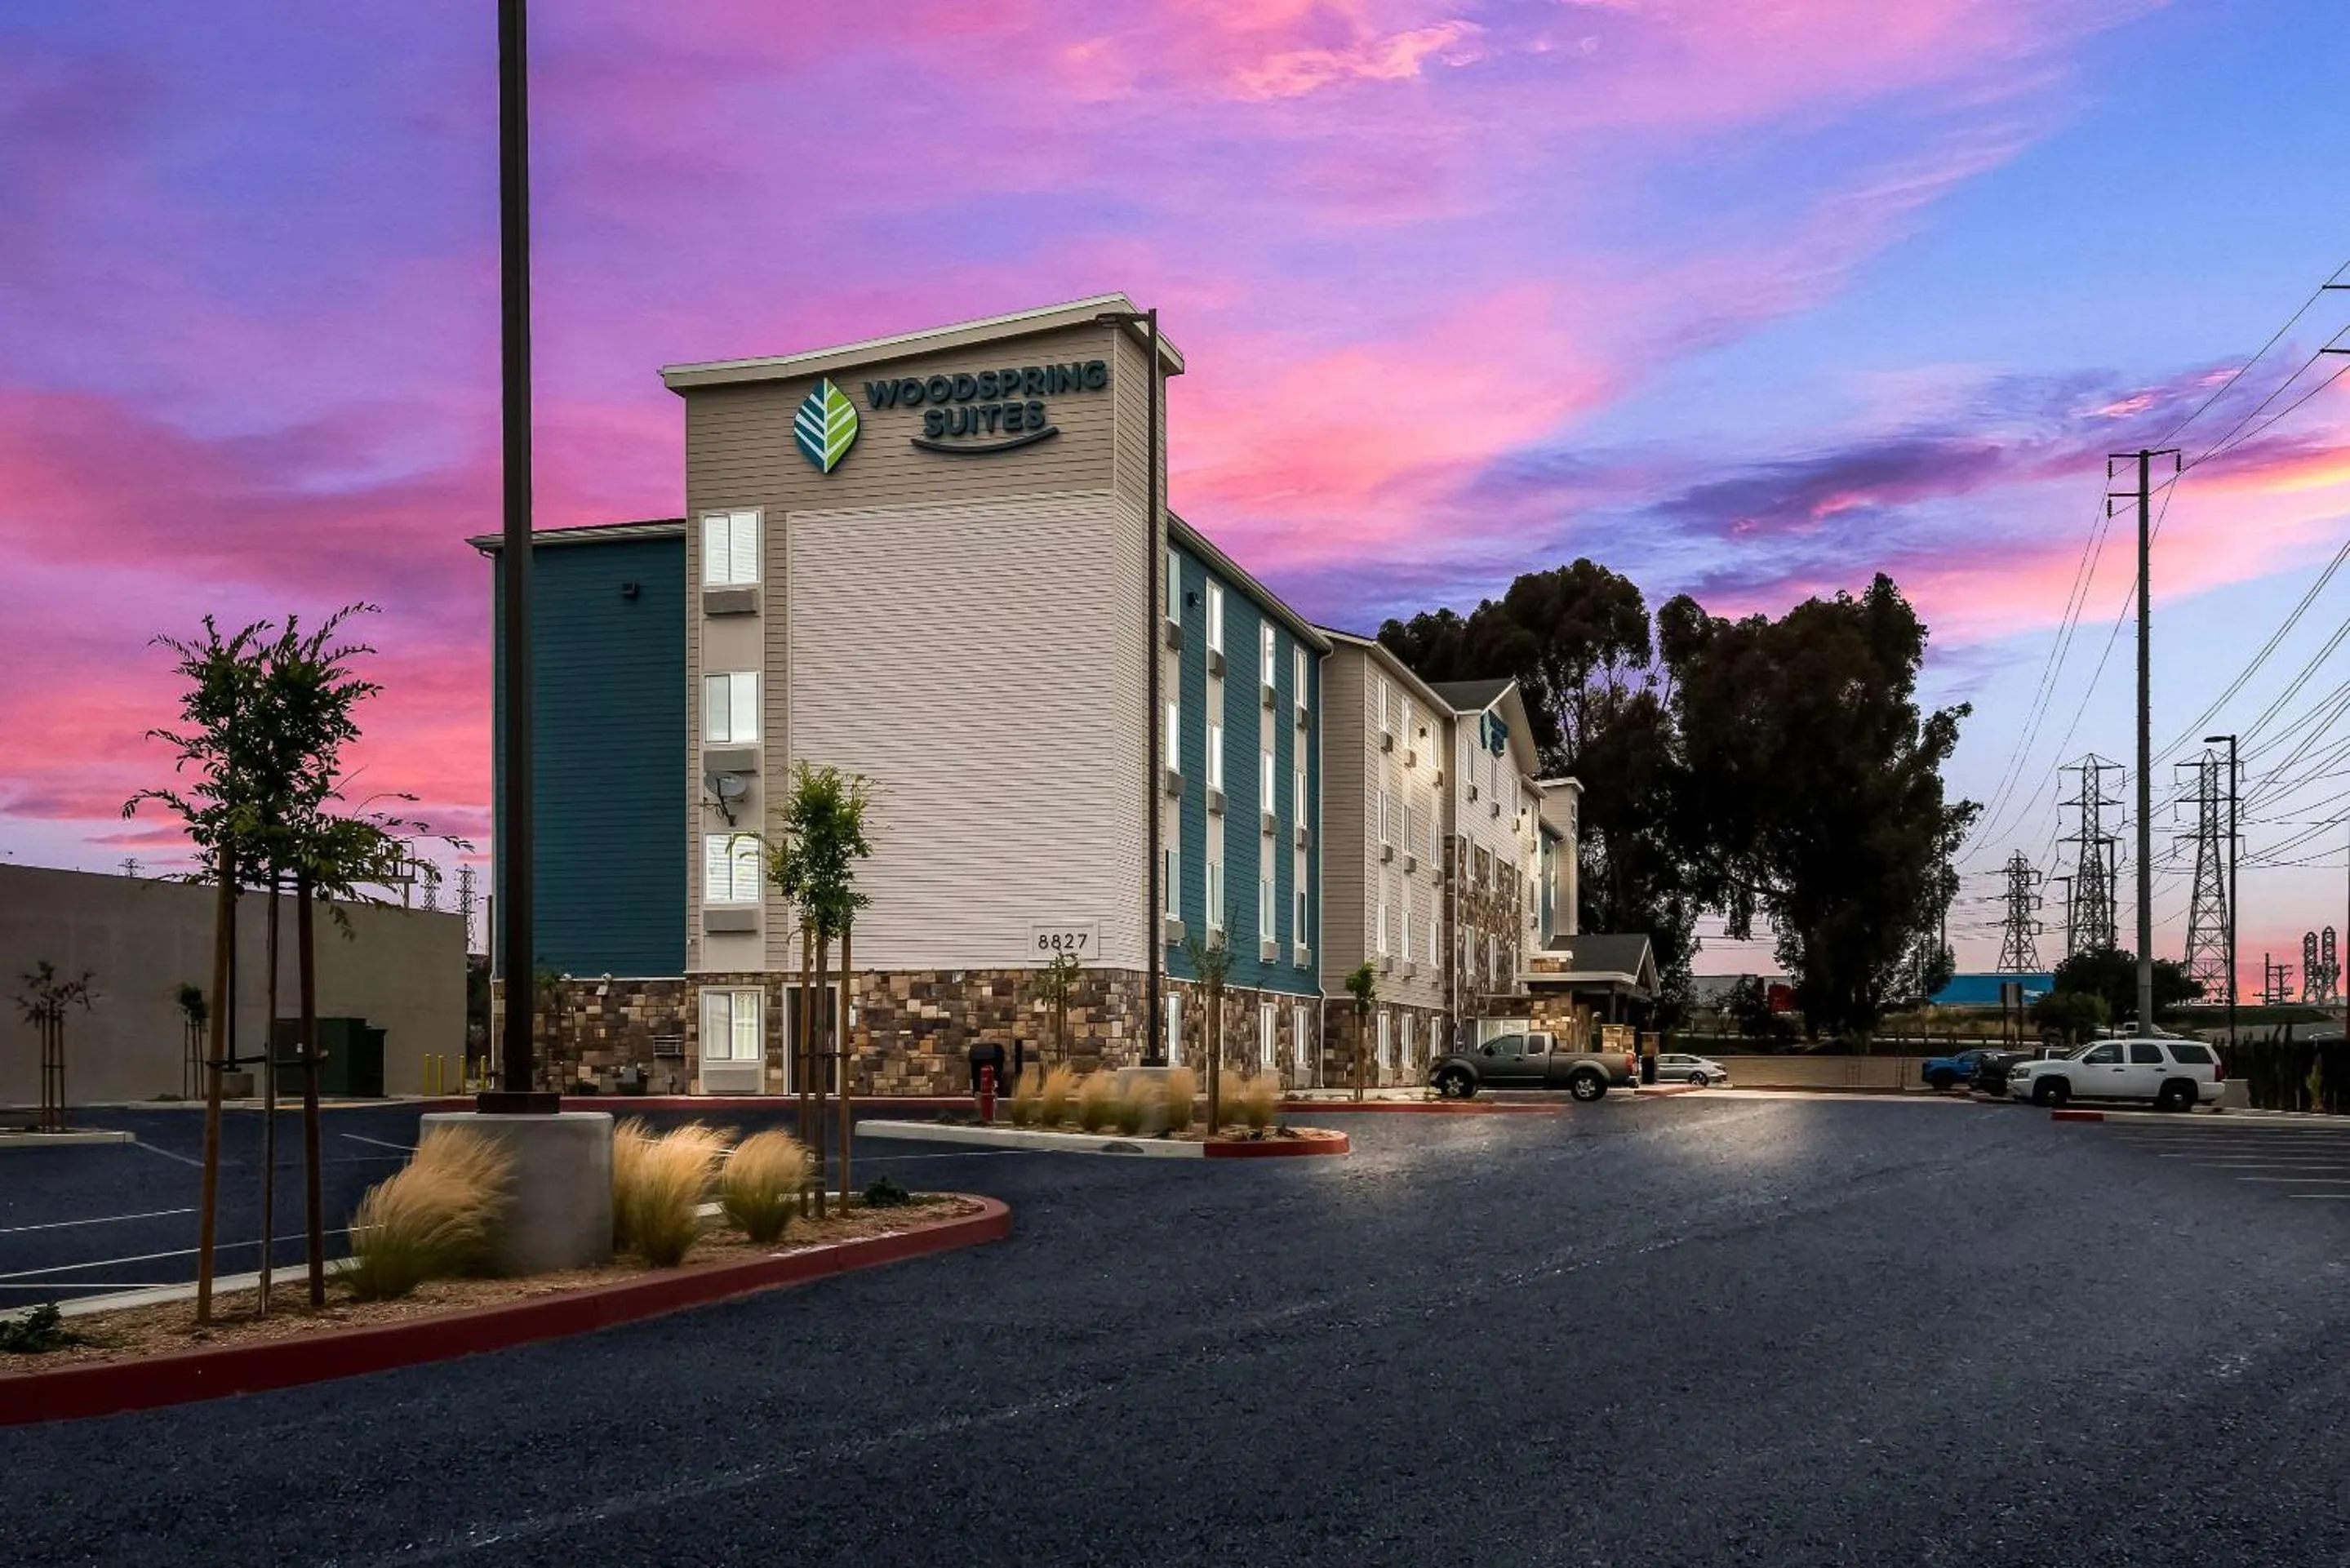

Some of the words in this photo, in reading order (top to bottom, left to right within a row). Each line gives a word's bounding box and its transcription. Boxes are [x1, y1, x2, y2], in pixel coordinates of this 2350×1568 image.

[864, 360, 1107, 408] WOODSPRING
[923, 400, 1046, 438] SUITES
[1038, 933, 1088, 949] 8827
